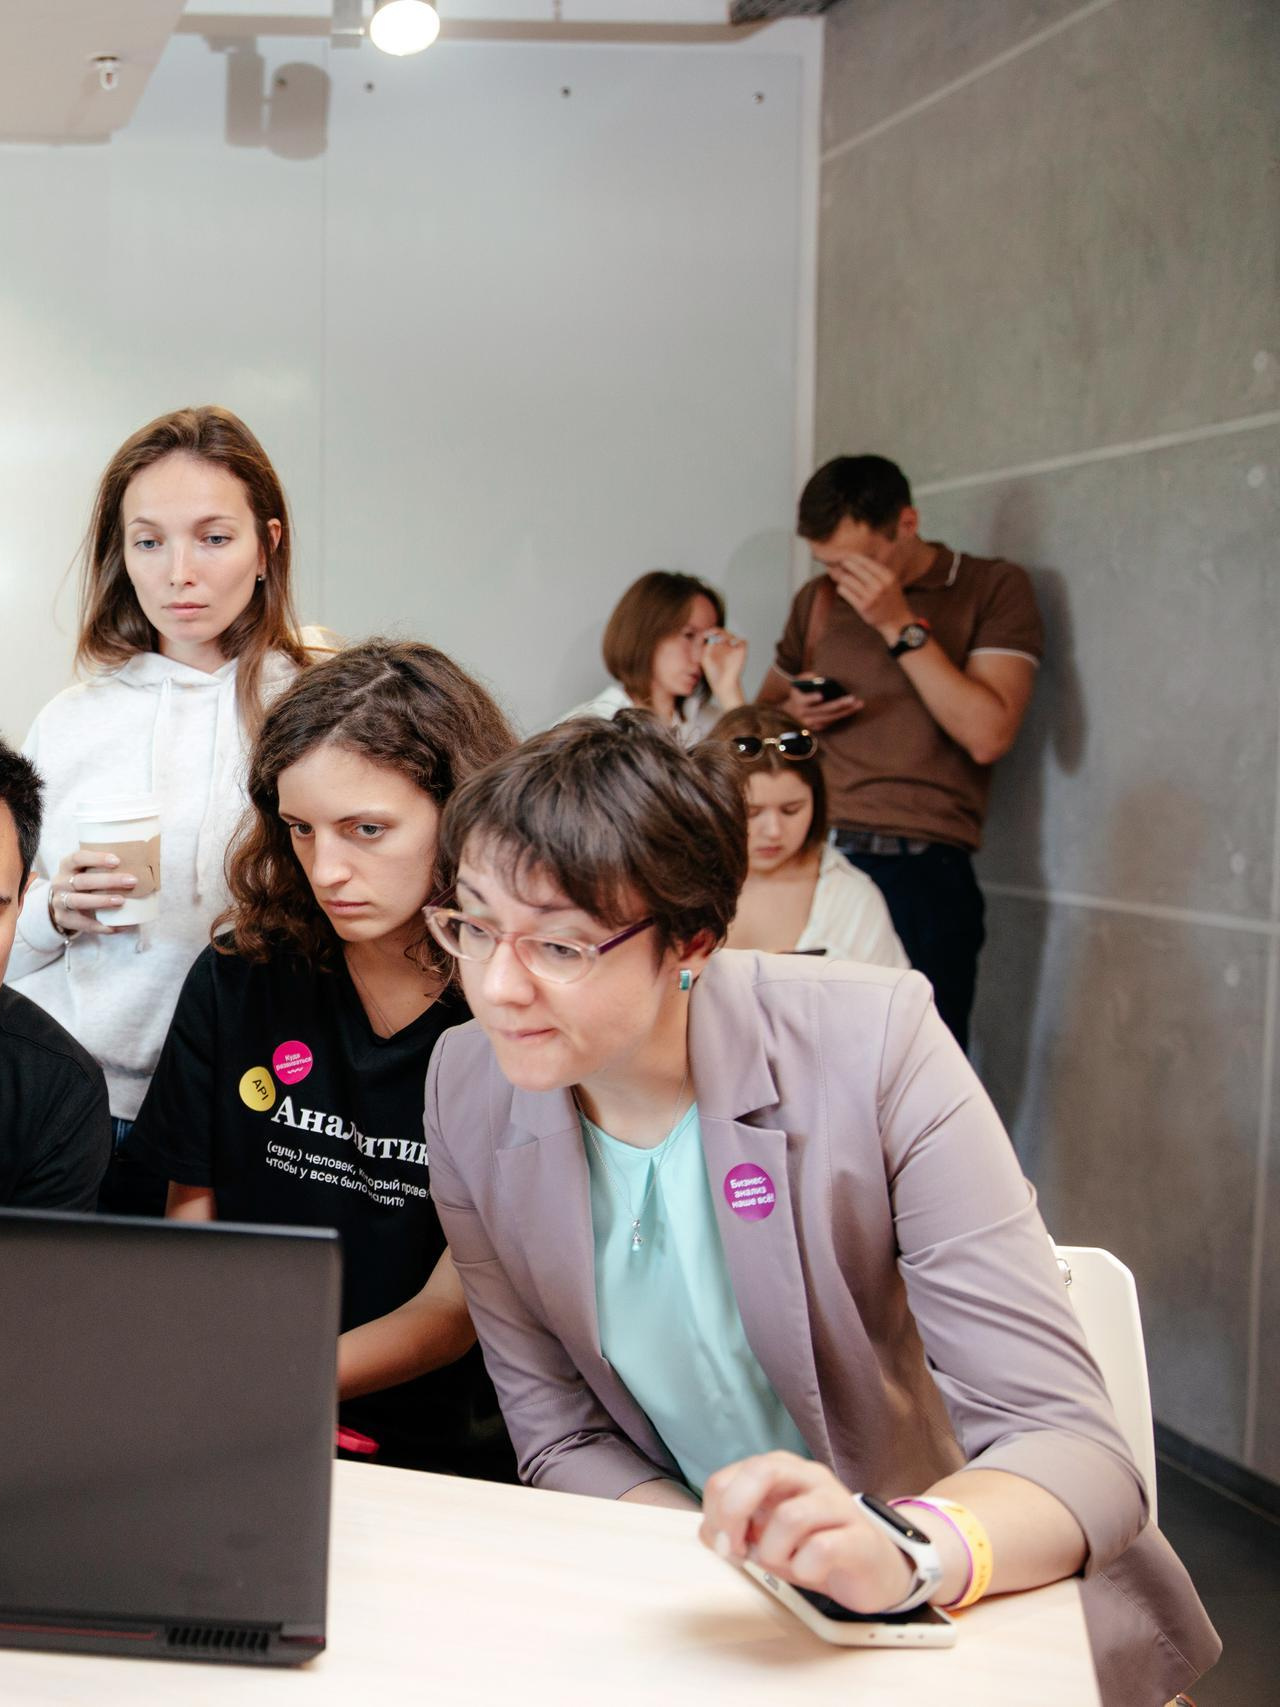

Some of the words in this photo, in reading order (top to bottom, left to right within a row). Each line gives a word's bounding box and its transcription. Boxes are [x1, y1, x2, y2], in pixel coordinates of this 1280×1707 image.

[252, 1078, 269, 1101] API
[271, 1095, 429, 1167] Аналитик
[266, 1140, 303, 1162] (сущ.)
[305, 1152, 357, 1176] человек,
[401, 1182, 431, 1200] прове
[266, 1157, 298, 1175] чтобы
[299, 1167, 308, 1179] у
[310, 1169, 339, 1185] всех
[341, 1176, 368, 1193] было
[730, 1176, 767, 1189] Бизнес-
